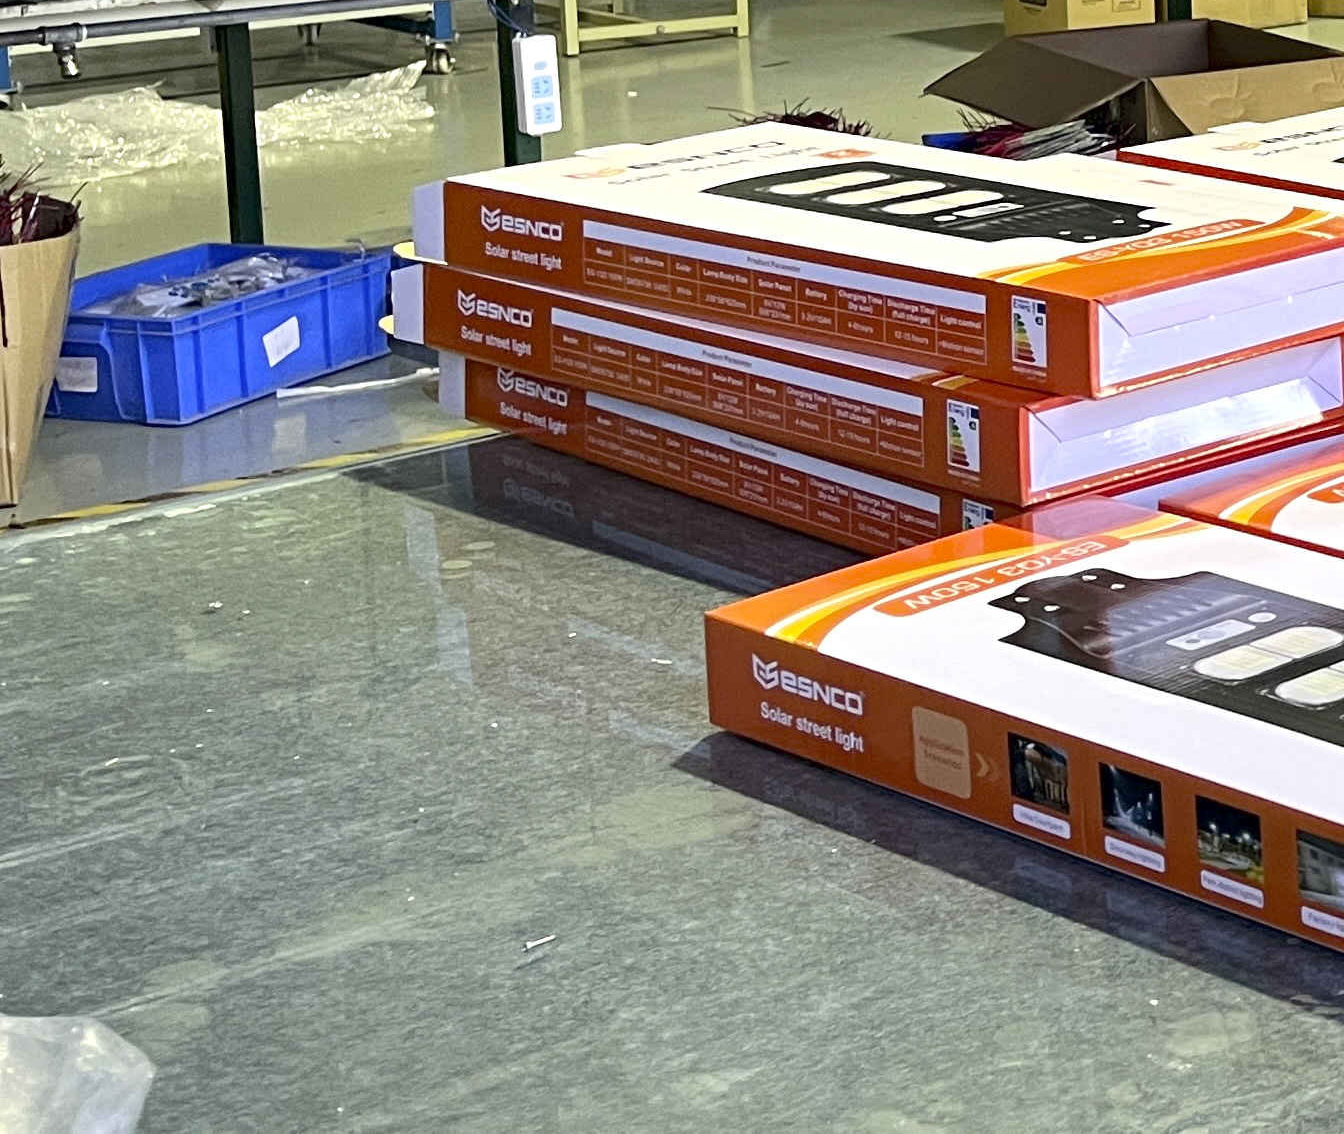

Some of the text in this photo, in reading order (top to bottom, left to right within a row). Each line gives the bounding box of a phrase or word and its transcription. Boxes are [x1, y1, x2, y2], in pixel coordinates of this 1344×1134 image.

[485, 241, 562, 271] Solar street light
[461, 324, 532, 357] Solar street light
[500, 401, 568, 435] Solar street light
[903, 540, 1106, 610] ES-Y03 150W
[760, 701, 864, 753] Solar street light
